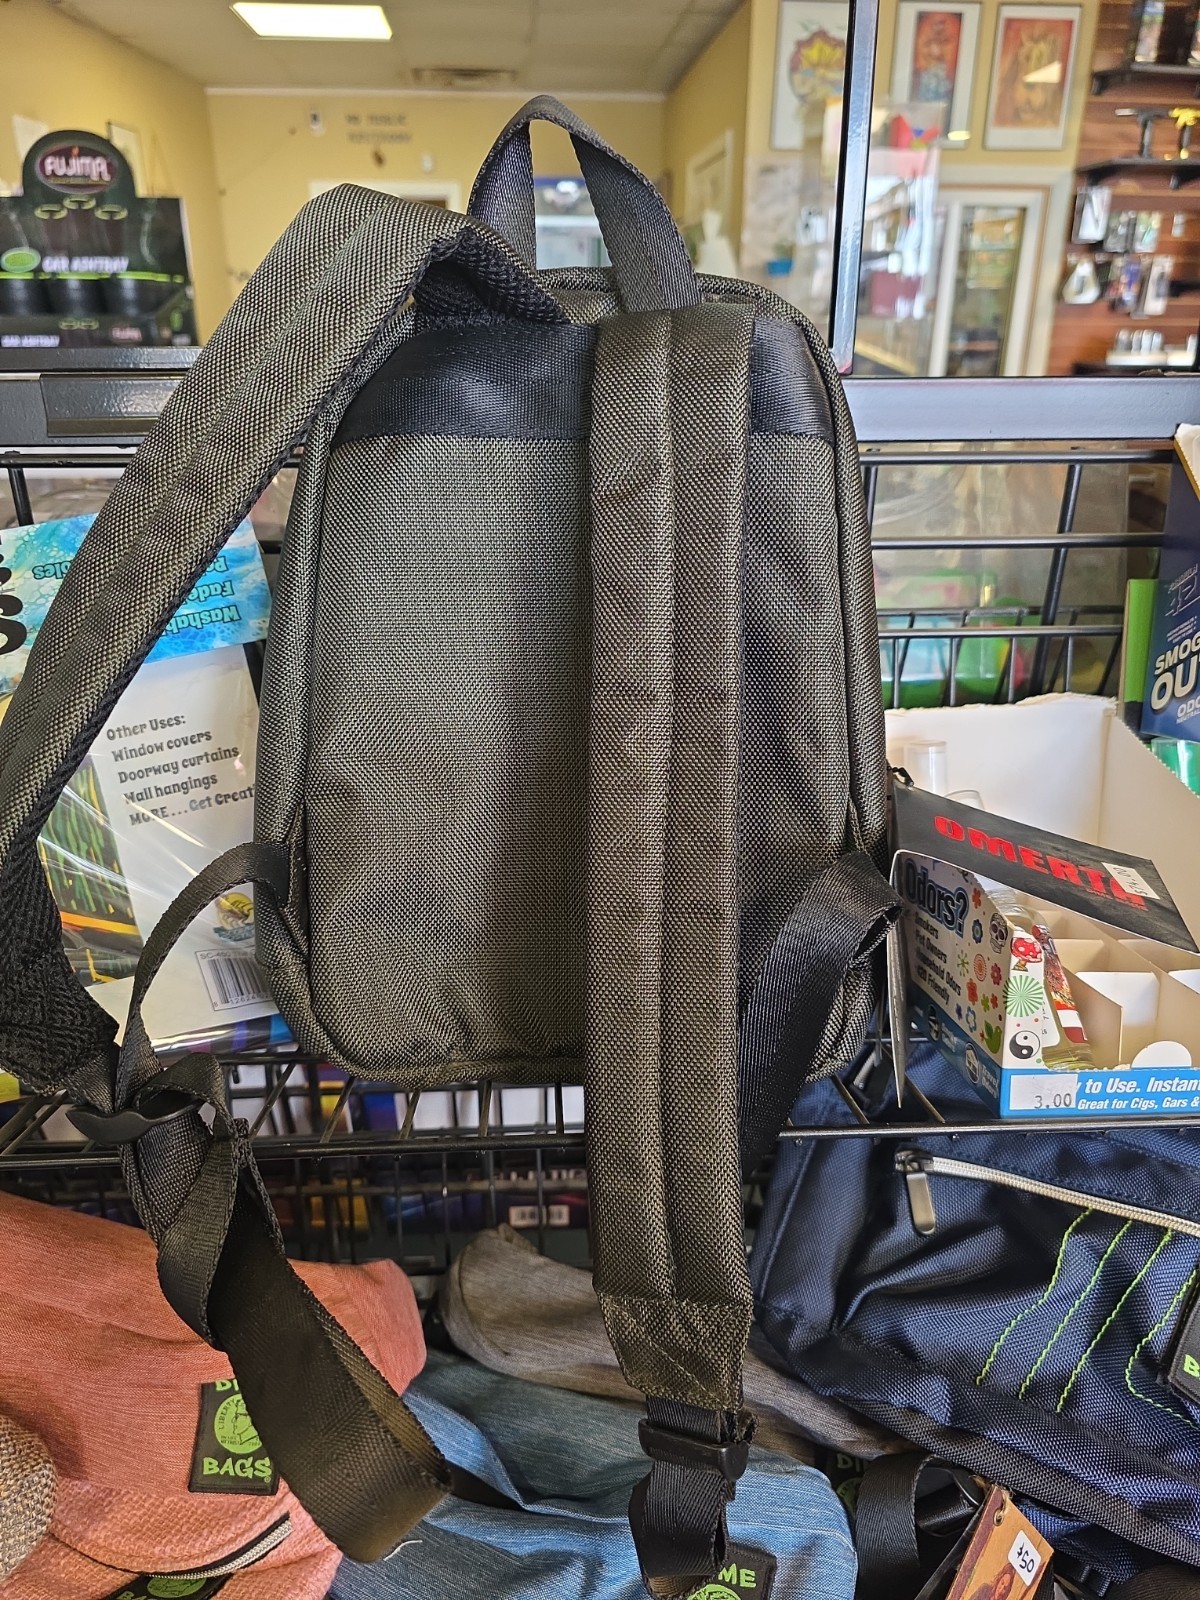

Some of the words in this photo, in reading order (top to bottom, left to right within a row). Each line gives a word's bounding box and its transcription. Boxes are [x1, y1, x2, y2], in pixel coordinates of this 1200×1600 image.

[45, 156, 111, 181] FUJIMA
[162, 605, 242, 636] Washab
[1151, 653, 1200, 710] OU
[106, 723, 147, 741] Other
[149, 715, 186, 731] Uses:
[111, 743, 164, 762] Window
[167, 731, 212, 750] covers
[118, 760, 179, 784] Doorway
[182, 746, 240, 769] curtains
[124, 786, 152, 804] Wall
[155, 774, 218, 798] hangings
[904, 858, 969, 938] Odors?
[927, 938, 947, 964] Owners
[928, 972, 949, 1005] Friendly
[946, 969, 961, 996] Odors
[1085, 1080, 1103, 1094] to
[1106, 1078, 1141, 1093] Use.
[1146, 1077, 1200, 1092] Instan
[1034, 1093, 1072, 1109] 3.00
[1078, 1099, 1108, 1110] Great
[1112, 1098, 1129, 1110] for
[1130, 1098, 1158, 1110] Cigs,
[1190, 1096, 1200, 1107] &
[203, 1457, 272, 1479] BAGS
[1017, 1542, 1035, 1573] $50
